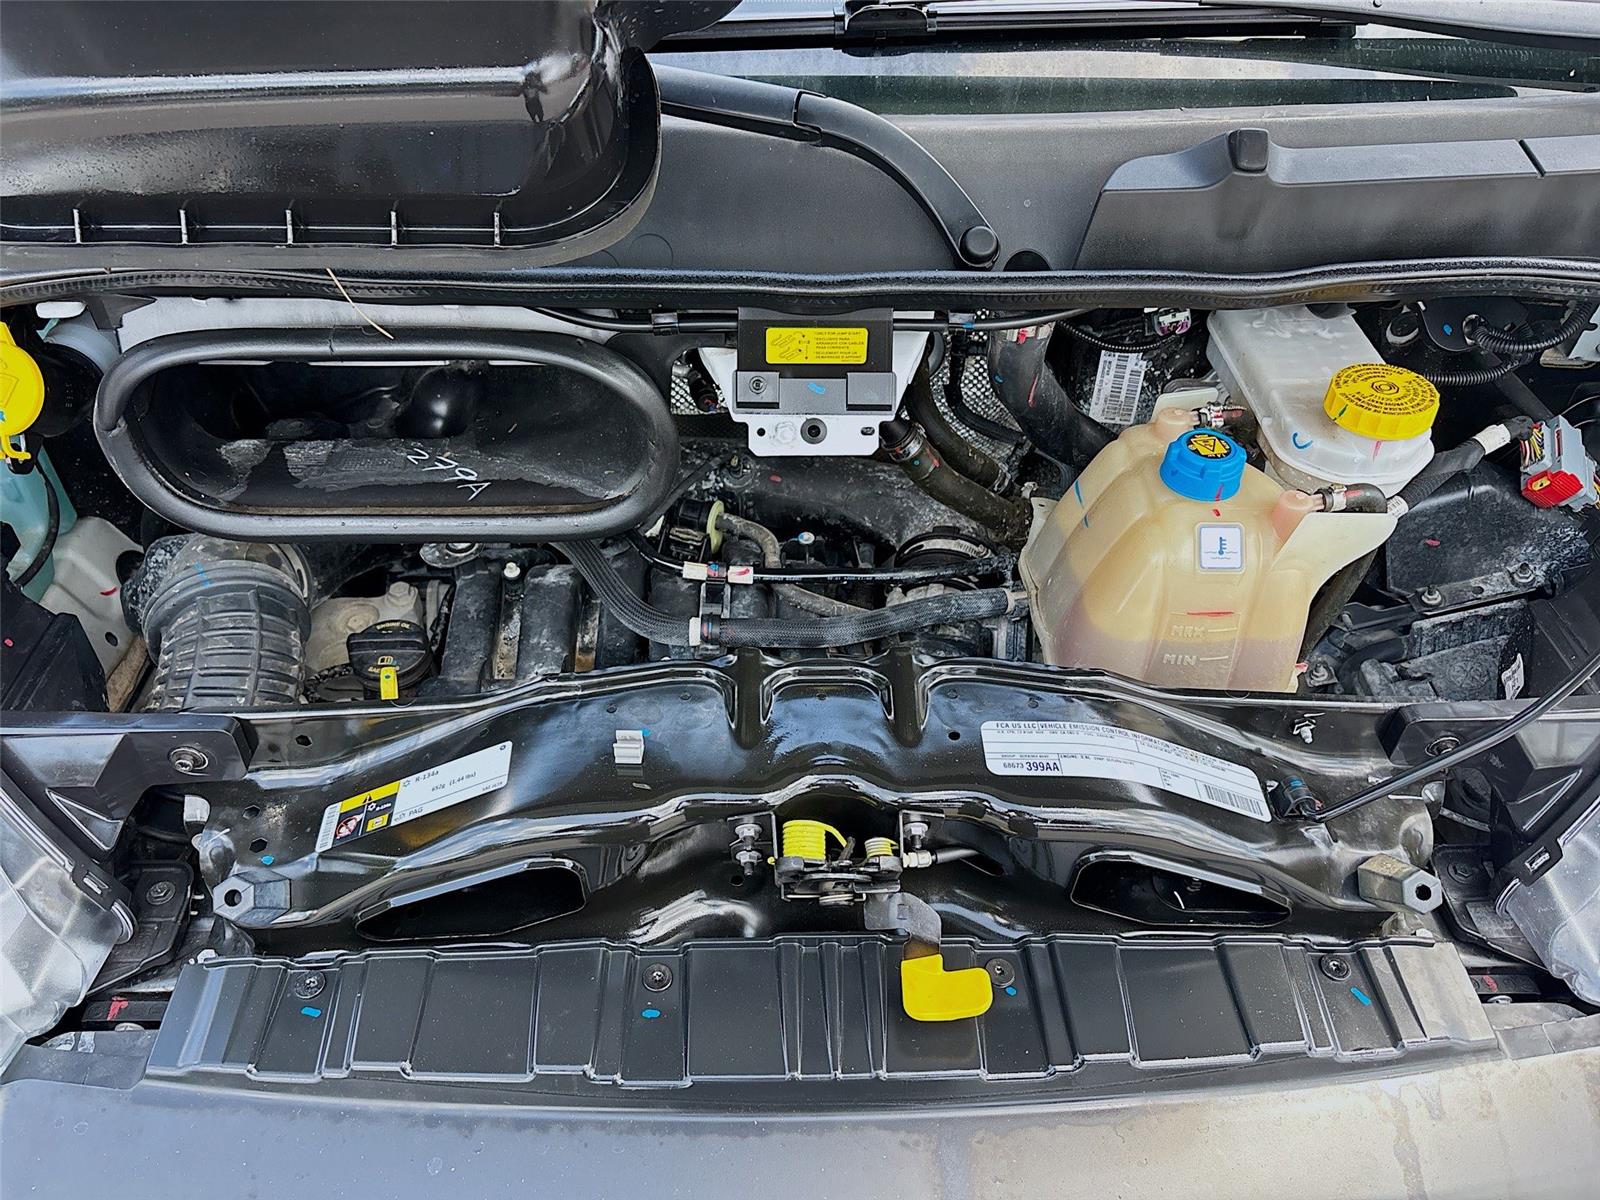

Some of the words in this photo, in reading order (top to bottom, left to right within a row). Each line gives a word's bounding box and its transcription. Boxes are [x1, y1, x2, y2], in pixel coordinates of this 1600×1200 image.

[1171, 625, 1205, 638] MAX
[1162, 653, 1198, 666] MIN
[1101, 726, 1130, 737] CONTROL
[1025, 761, 1060, 771] 399AA
[409, 807, 423, 817] PAG
